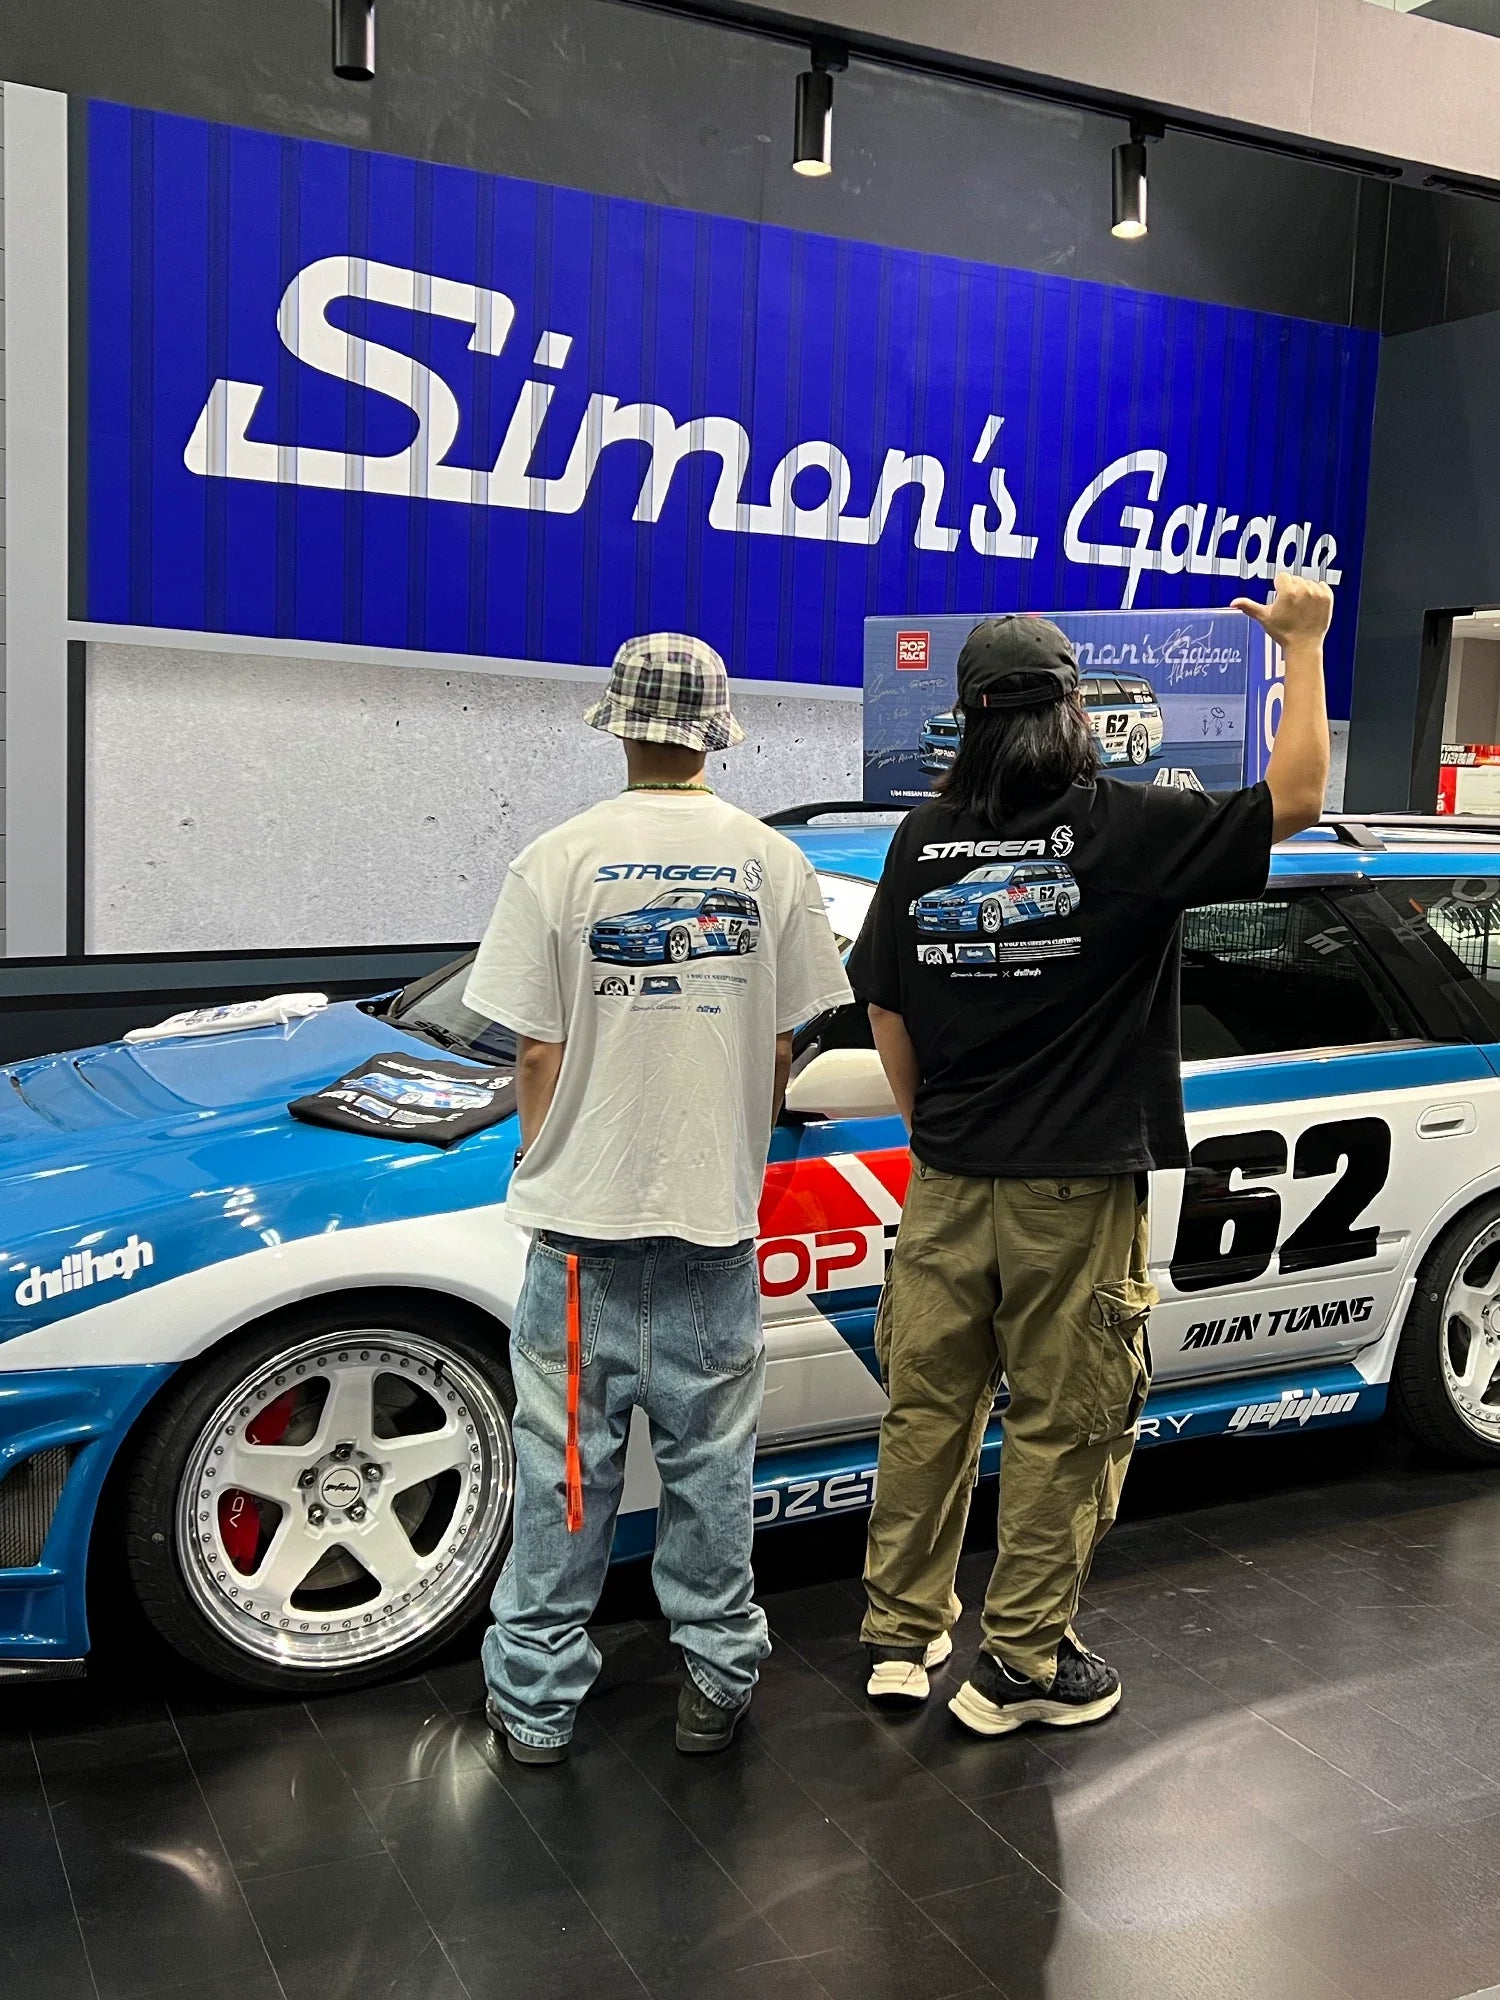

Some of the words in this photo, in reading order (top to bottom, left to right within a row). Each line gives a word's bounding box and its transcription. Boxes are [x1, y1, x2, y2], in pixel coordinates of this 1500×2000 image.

[184, 256, 1039, 560] Simon's
[1063, 449, 1343, 609] Garage
[899, 651, 926, 661] RACE
[900, 640, 926, 651] POP
[1069, 634, 1159, 665] mon's
[1164, 635, 1242, 673] Garage
[1105, 714, 1129, 737] 62
[902, 790, 923, 798] NISSAN
[917, 838, 1046, 862] STAGEA
[593, 863, 737, 883] STAGEA
[1039, 885, 1056, 902] 62
[728, 919, 743, 936] 62
[1168, 1116, 1392, 1293] 62
[756, 1229, 868, 1298] OP
